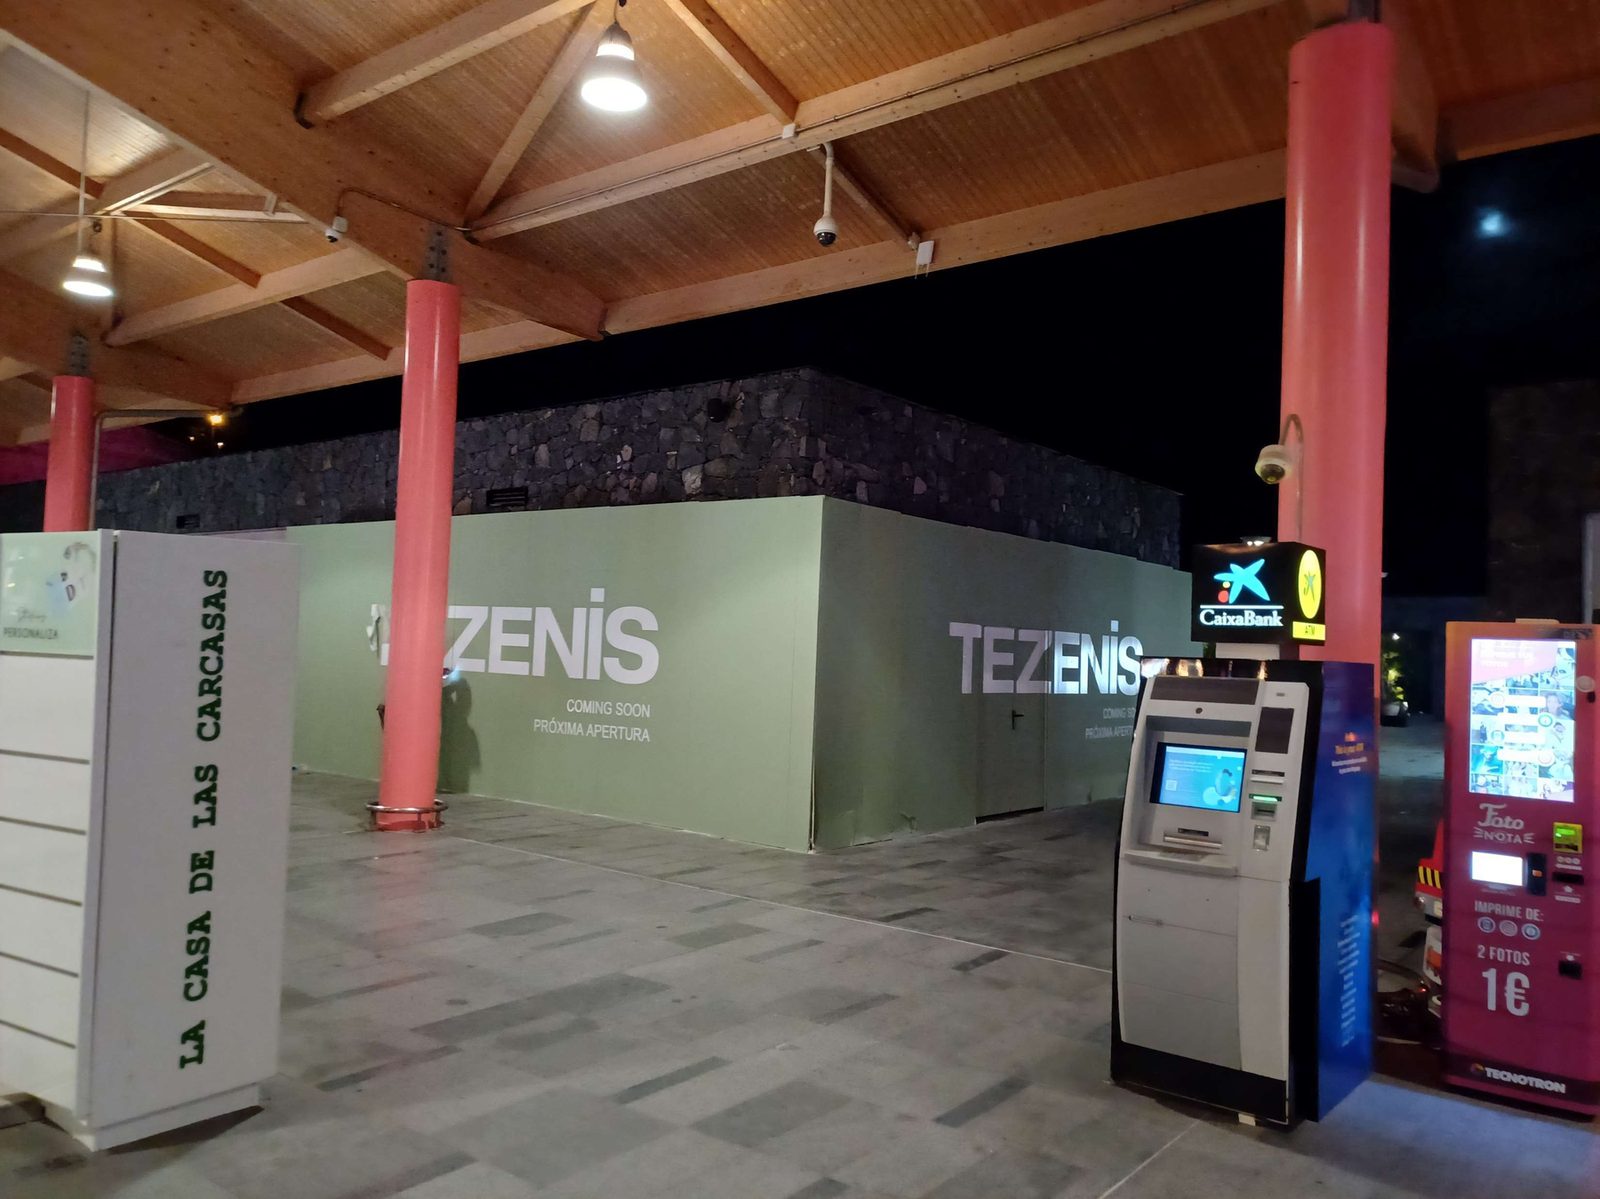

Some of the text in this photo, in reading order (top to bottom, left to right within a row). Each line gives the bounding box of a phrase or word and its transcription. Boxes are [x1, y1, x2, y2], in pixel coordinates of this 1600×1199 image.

[1200, 608, 1284, 627] CaixaBank
[566, 698, 651, 718] COMING SOON
[533, 717, 651, 743] PRÓXIMA APERTURA
[180, 568, 228, 1070] LA CASA DE LAS CARCASAS
[1477, 803, 1524, 830] Foto
[1484, 830, 1523, 845] NOTA
[1474, 900, 1522, 919] IMPRIME
[1477, 945, 1531, 967] 2 FOTOS
[1484, 1066, 1567, 1094] TECNOTRON
